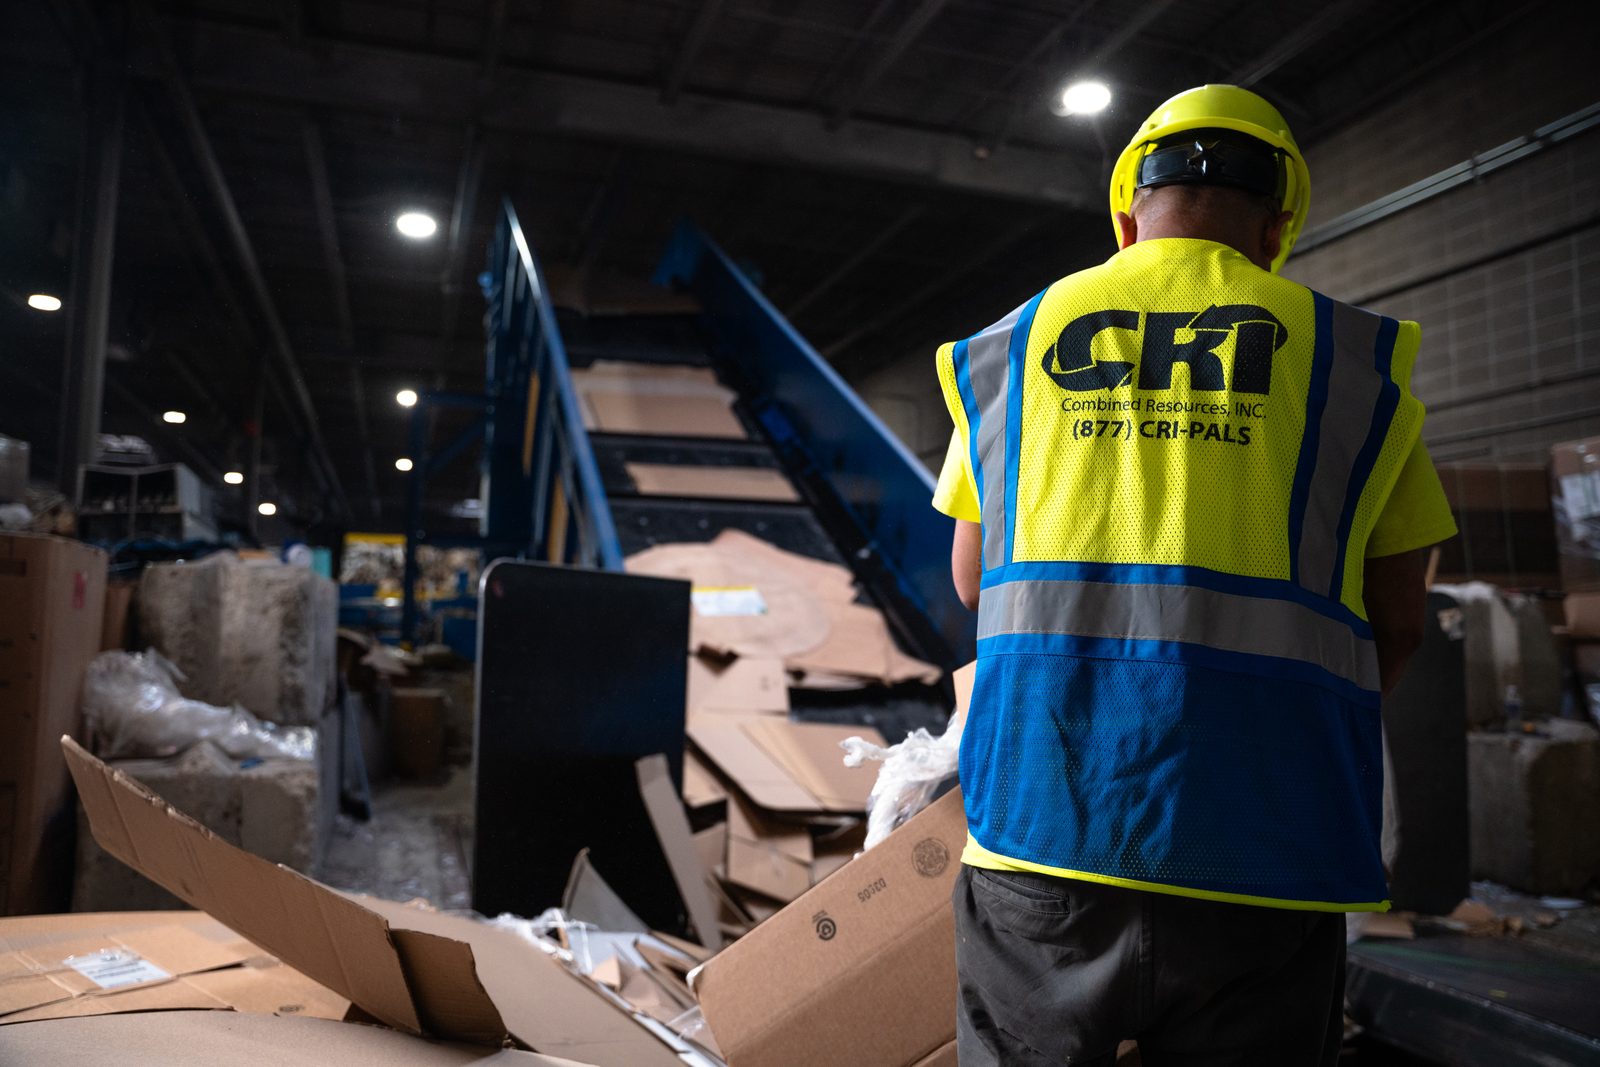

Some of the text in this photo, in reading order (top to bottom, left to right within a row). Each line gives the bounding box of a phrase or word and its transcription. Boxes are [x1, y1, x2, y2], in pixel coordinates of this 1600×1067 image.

[1042, 304, 1288, 395] CRI
[1061, 398, 1267, 419] Combined Resources, INC.
[1073, 419, 1250, 446] (877) CRI-PALS
